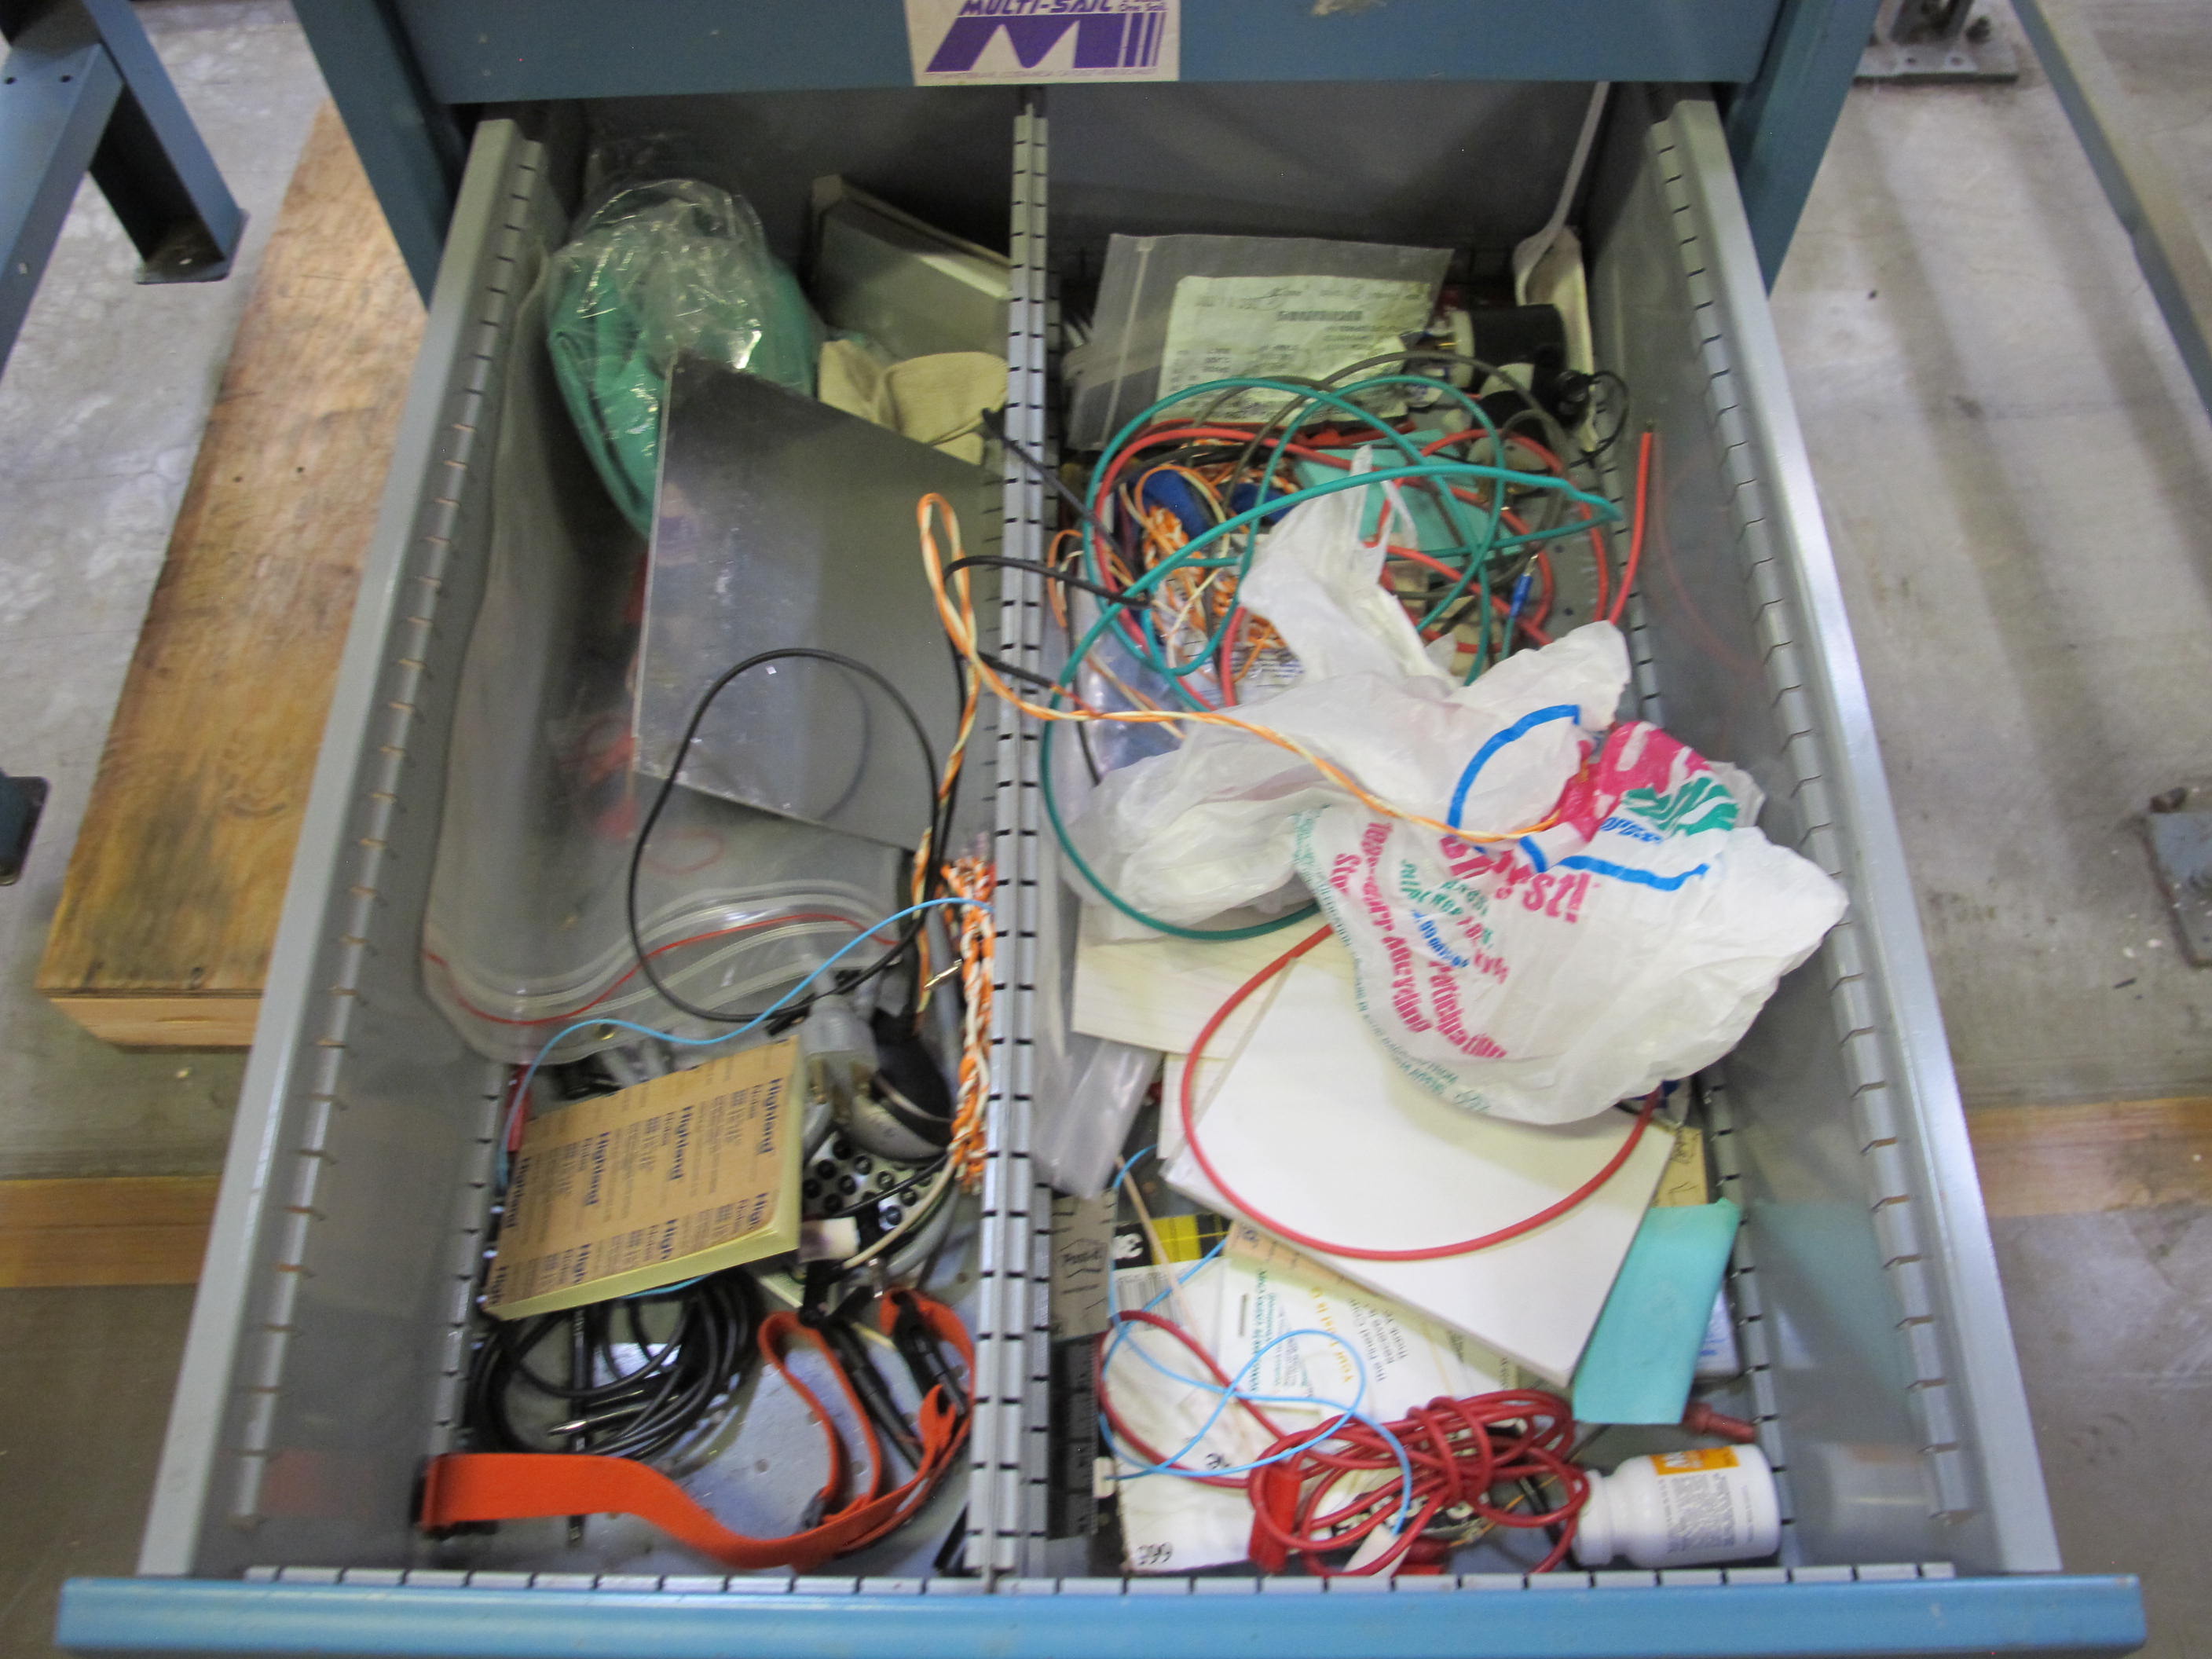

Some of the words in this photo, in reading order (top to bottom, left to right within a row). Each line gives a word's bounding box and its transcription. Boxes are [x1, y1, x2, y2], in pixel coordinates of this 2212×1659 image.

[670, 1105, 694, 1180] Highland
[757, 1079, 782, 1155] Highland
[585, 1132, 611, 1206] Highland
